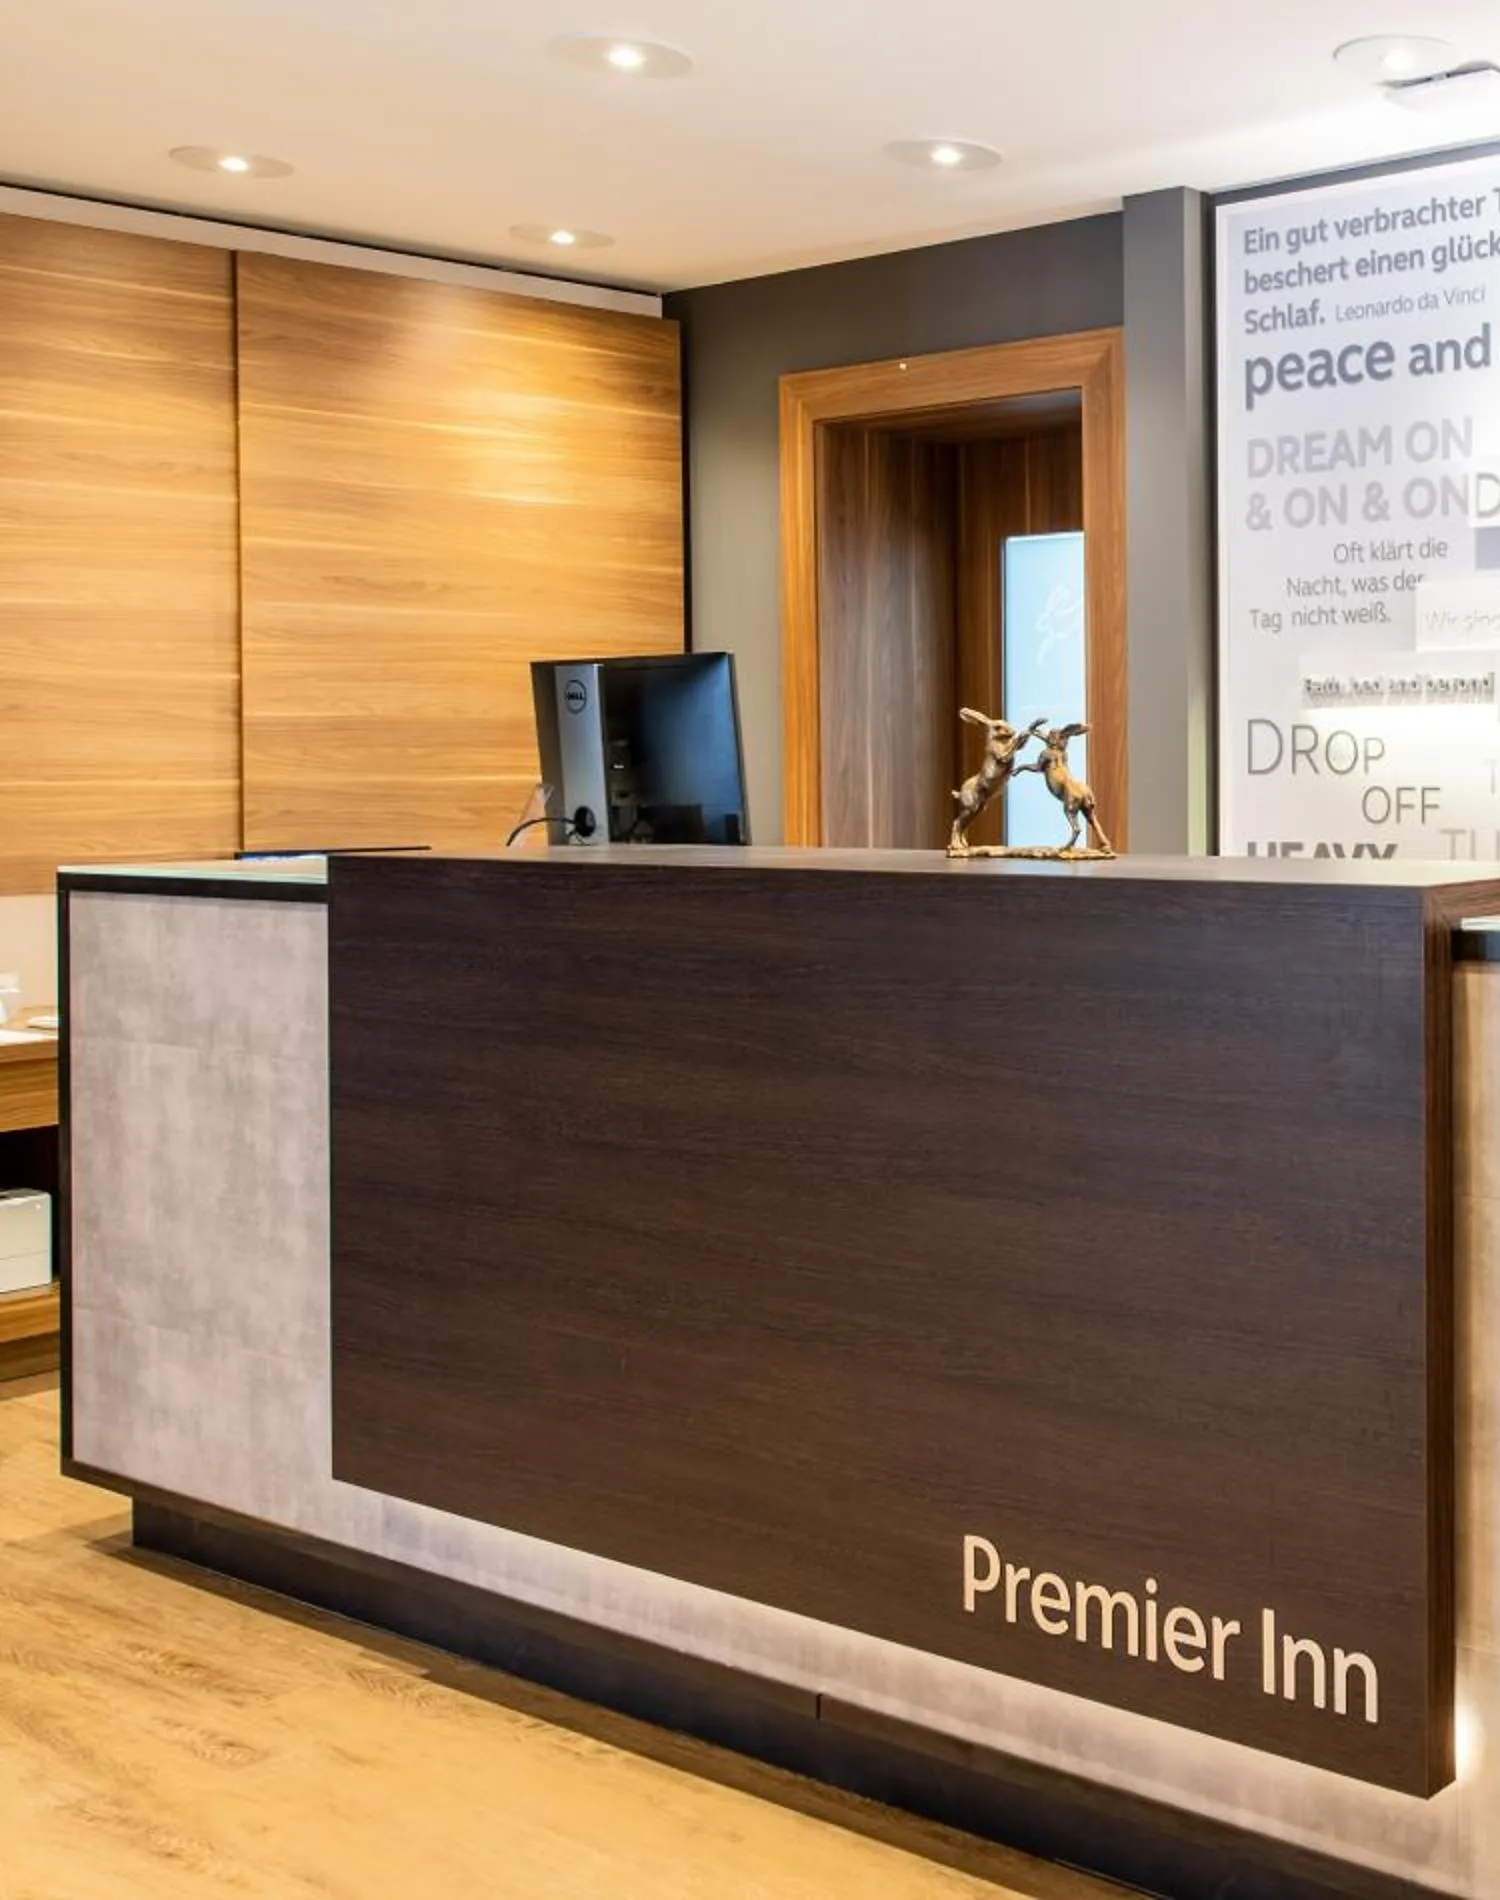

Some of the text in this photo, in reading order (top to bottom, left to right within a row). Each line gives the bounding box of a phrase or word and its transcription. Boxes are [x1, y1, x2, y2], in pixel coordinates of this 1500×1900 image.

[1244, 228, 1279, 254] Ein
[1287, 219, 1328, 255] gut
[1335, 193, 1487, 239] verbrachter
[1245, 256, 1349, 294] beschert
[1356, 247, 1424, 277] einen
[1245, 285, 1486, 334] Schlaf. Leonardo da Vinci
[1245, 339, 1394, 411] peace
[1409, 322, 1491, 376] and
[1246, 416, 1473, 479] DREAM ON
[1245, 474, 1470, 532] & ON & ON
[1333, 536, 1449, 565] Oft klärt die
[1285, 568, 1426, 600] Nacht, was der
[1249, 600, 1392, 634] Tag nicht weiß.
[1246, 718, 1386, 776] DROP
[1361, 785, 1441, 825] OFF
[964, 1534, 1378, 1724] Premier Inn
